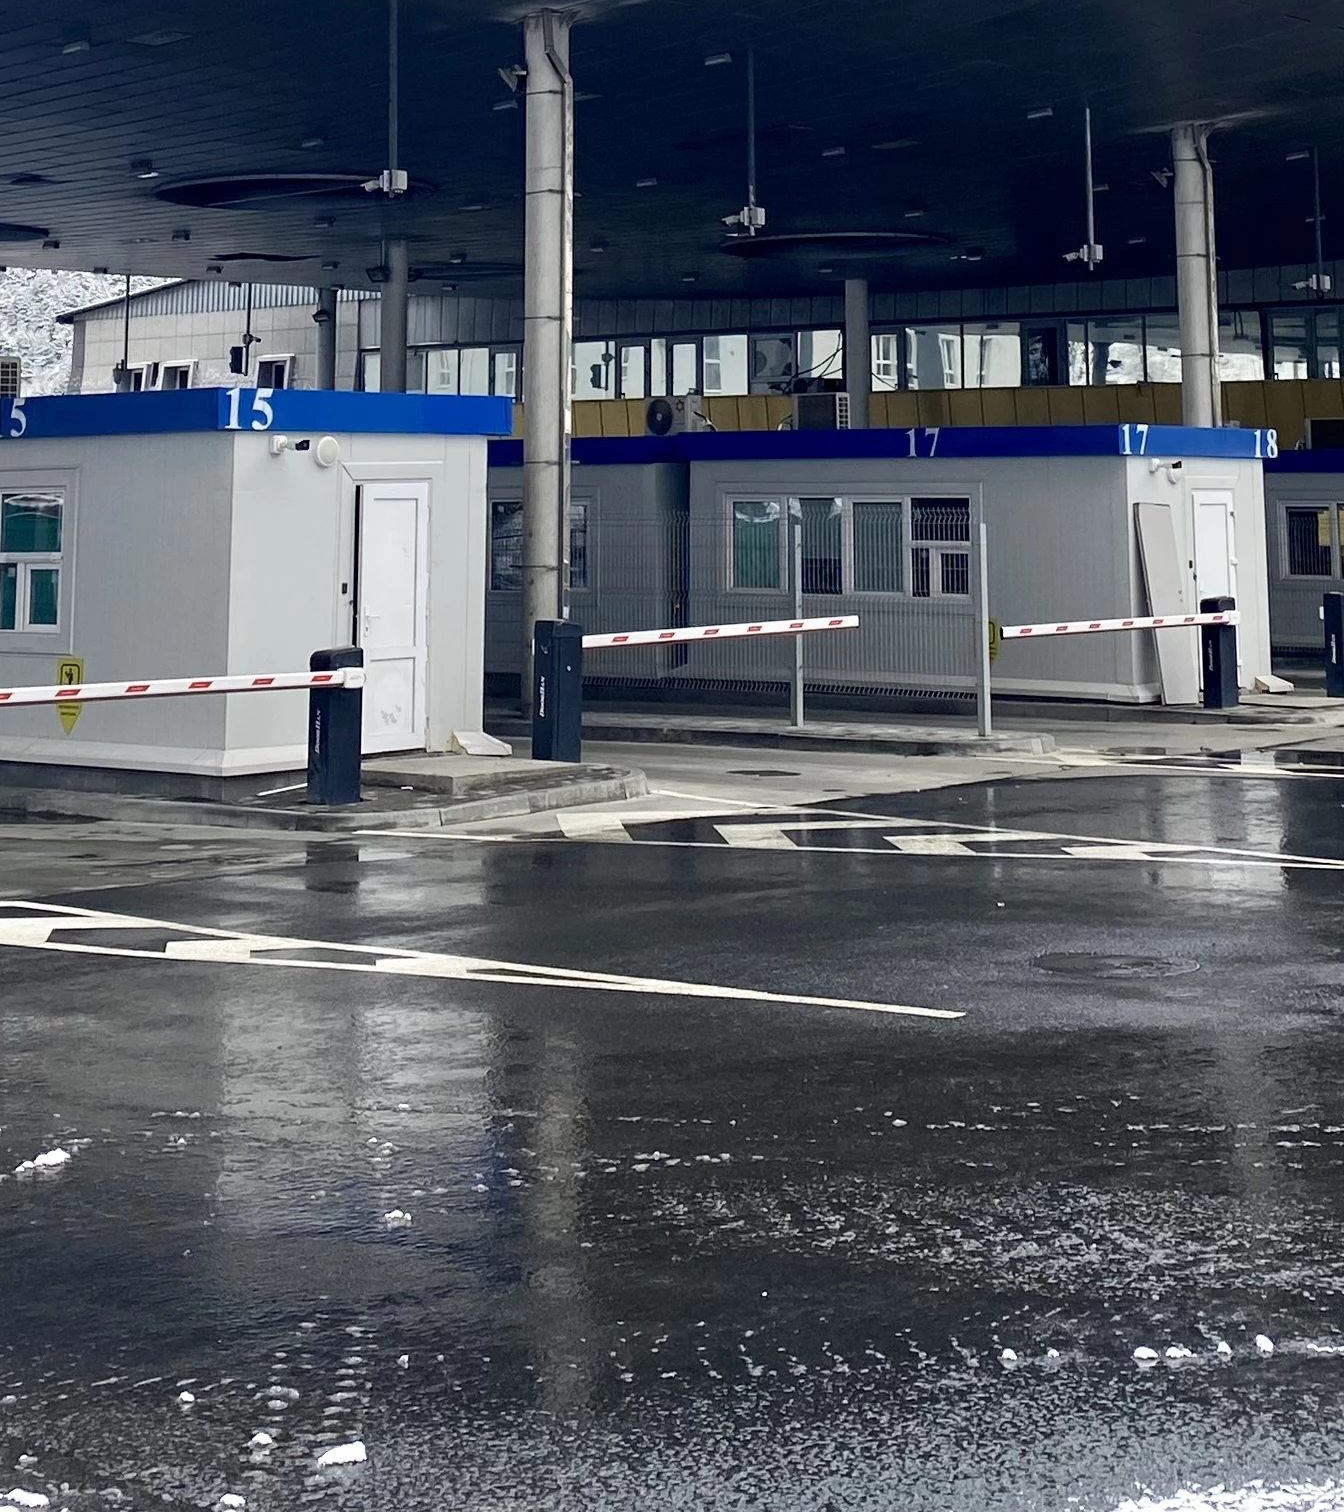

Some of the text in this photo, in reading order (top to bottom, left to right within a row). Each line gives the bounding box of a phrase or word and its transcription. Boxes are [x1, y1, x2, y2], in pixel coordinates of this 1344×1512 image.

[224, 387, 274, 431] 15
[905, 427, 940, 458] 17
[1121, 423, 1149, 455] 17
[1254, 428, 1278, 459] 18
